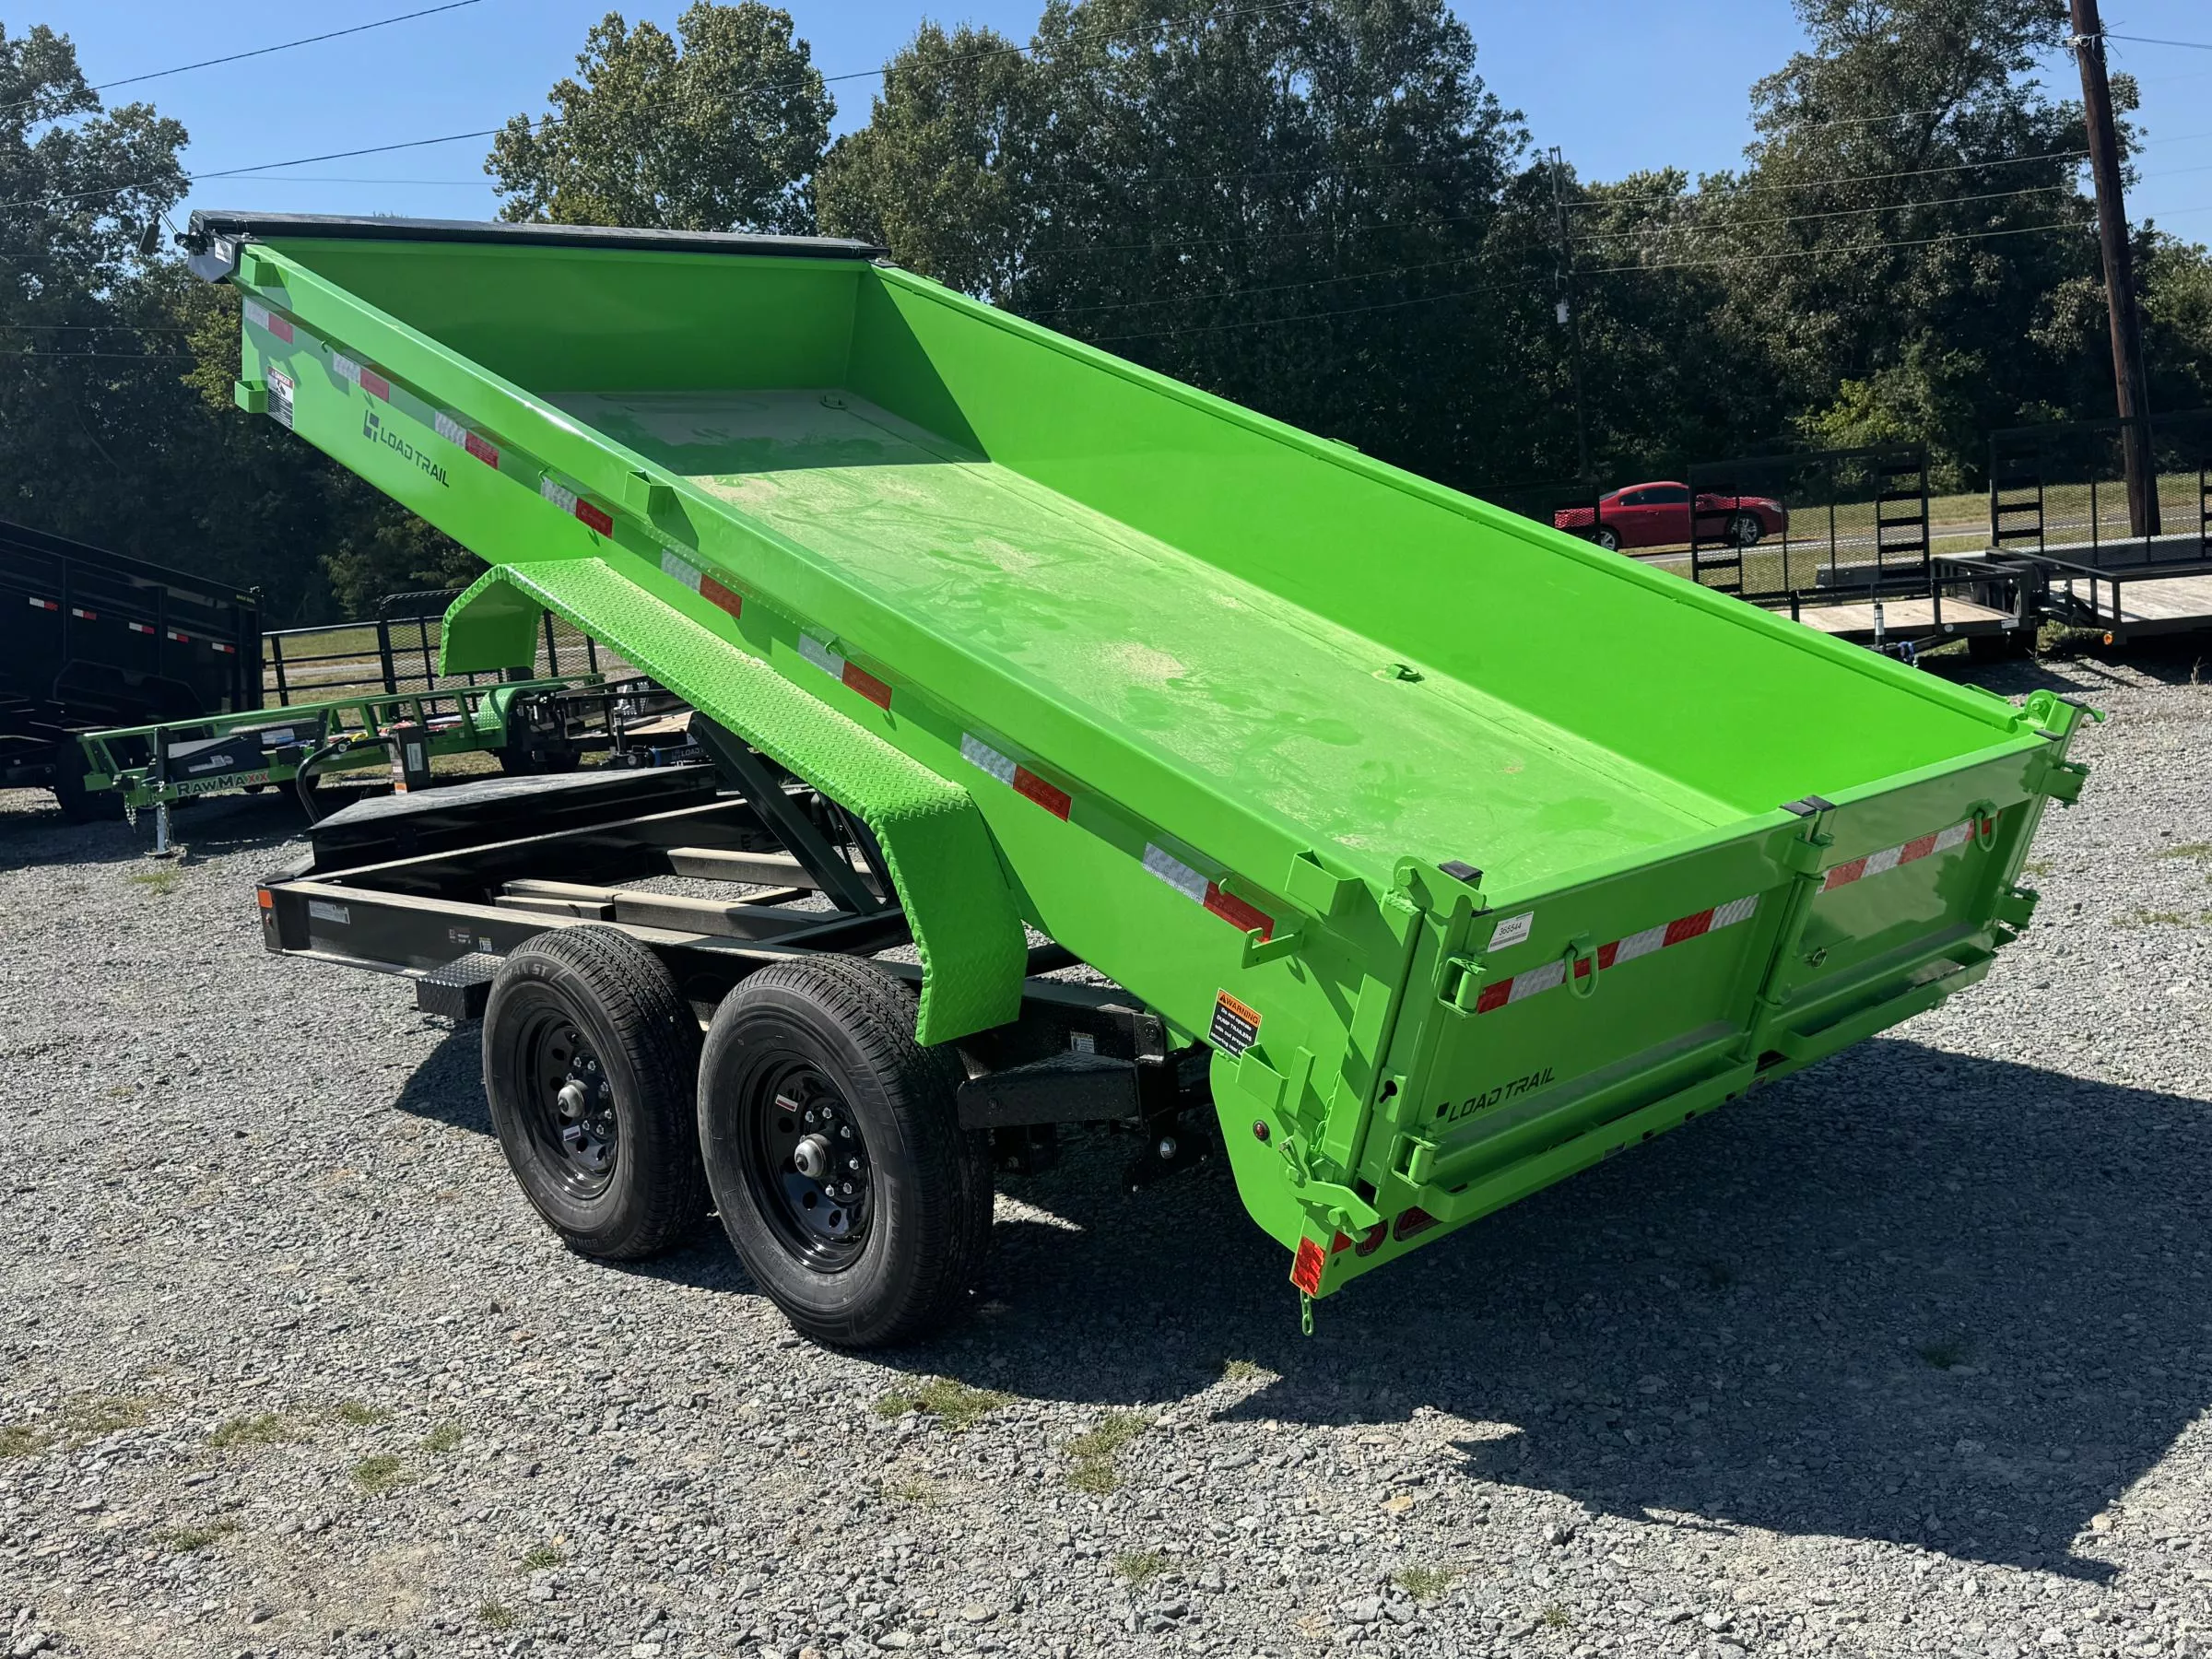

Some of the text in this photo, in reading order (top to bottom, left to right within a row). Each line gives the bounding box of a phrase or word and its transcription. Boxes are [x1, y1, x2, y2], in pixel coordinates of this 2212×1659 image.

[1225, 998, 1259, 1025] WARNING
[1217, 1014, 1253, 1041] DUMP TRAILERS
